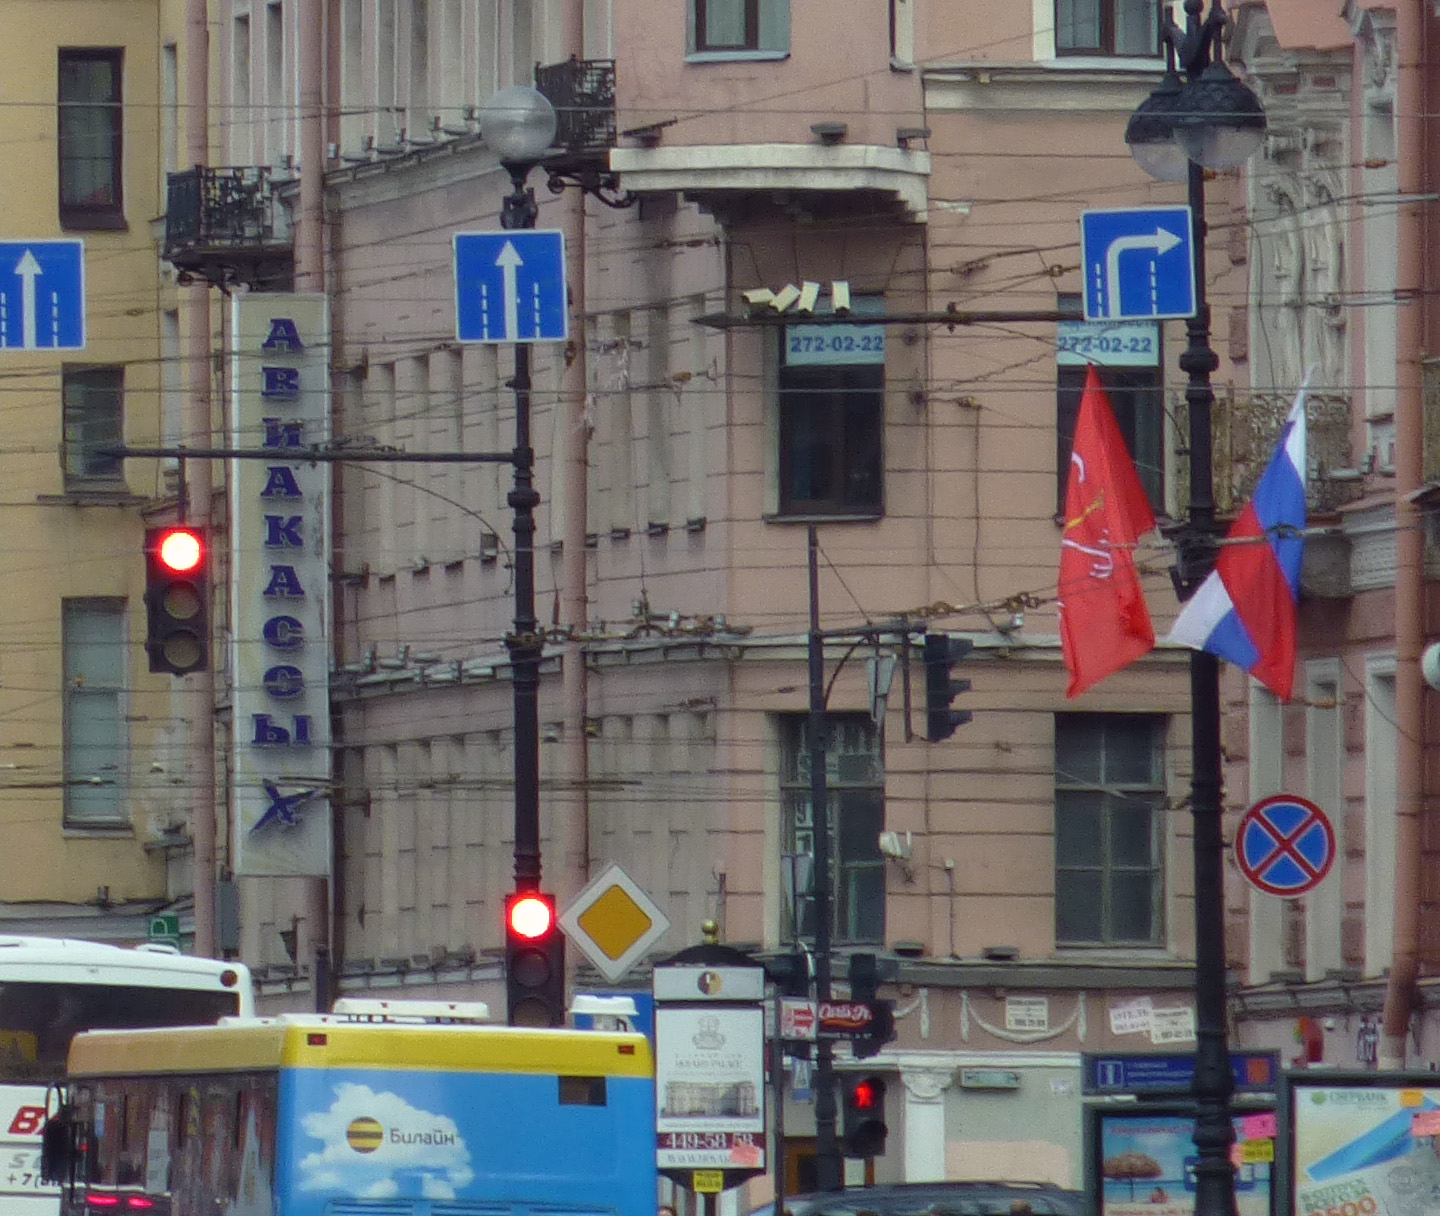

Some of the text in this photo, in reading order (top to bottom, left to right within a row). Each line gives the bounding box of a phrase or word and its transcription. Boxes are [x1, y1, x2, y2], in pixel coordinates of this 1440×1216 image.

[791, 335, 884, 354] 272-02-22
[1058, 335, 1153, 354] 272-02-22
[251, 317, 312, 748] АВИАКАССЫ
[390, 1128, 456, 1146] Билайн
